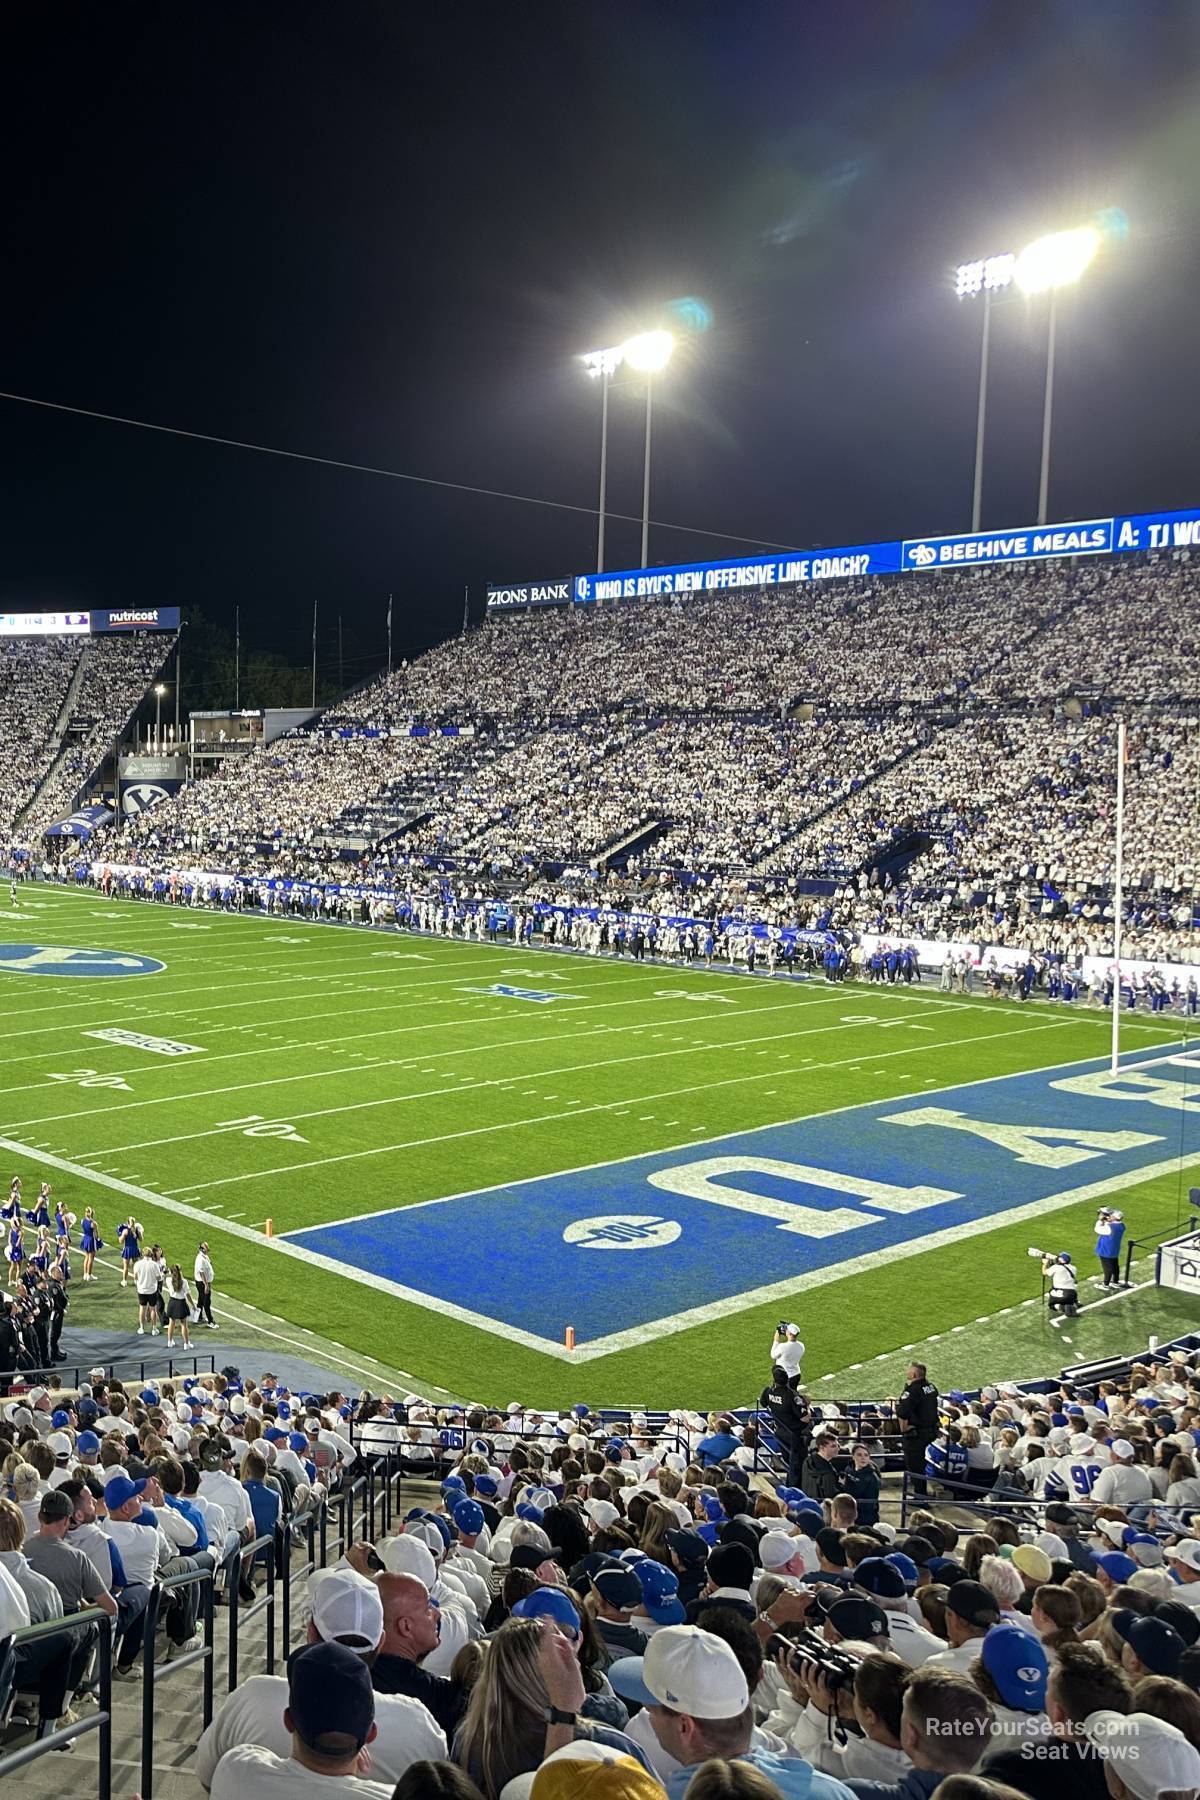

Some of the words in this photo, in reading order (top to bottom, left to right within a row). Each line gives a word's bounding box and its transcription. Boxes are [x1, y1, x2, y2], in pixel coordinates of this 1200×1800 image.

[939, 538, 1028, 562] BEEHIVE
[1033, 529, 1106, 553] MEALS
[1117, 520, 1140, 547] A:
[1148, 523, 1169, 548] TJ
[577, 576, 591, 599] Q:
[595, 579, 622, 600] WHO
[624, 577, 636, 597] IS
[637, 573, 673, 596] BYU'S
[674, 571, 704, 592] NEW
[705, 563, 776, 589] OFFENSIVE
[778, 560, 810, 583] LINE
[811, 554, 871, 579] COACH?
[487, 588, 528, 606] ZIONS
[530, 584, 569, 601] BANK
[109, 609, 159, 623] nutricost
[214, 1114, 297, 1137] 10
[768, 1394, 783, 1405] POLICE
[1071, 1464, 1102, 1494] 96
